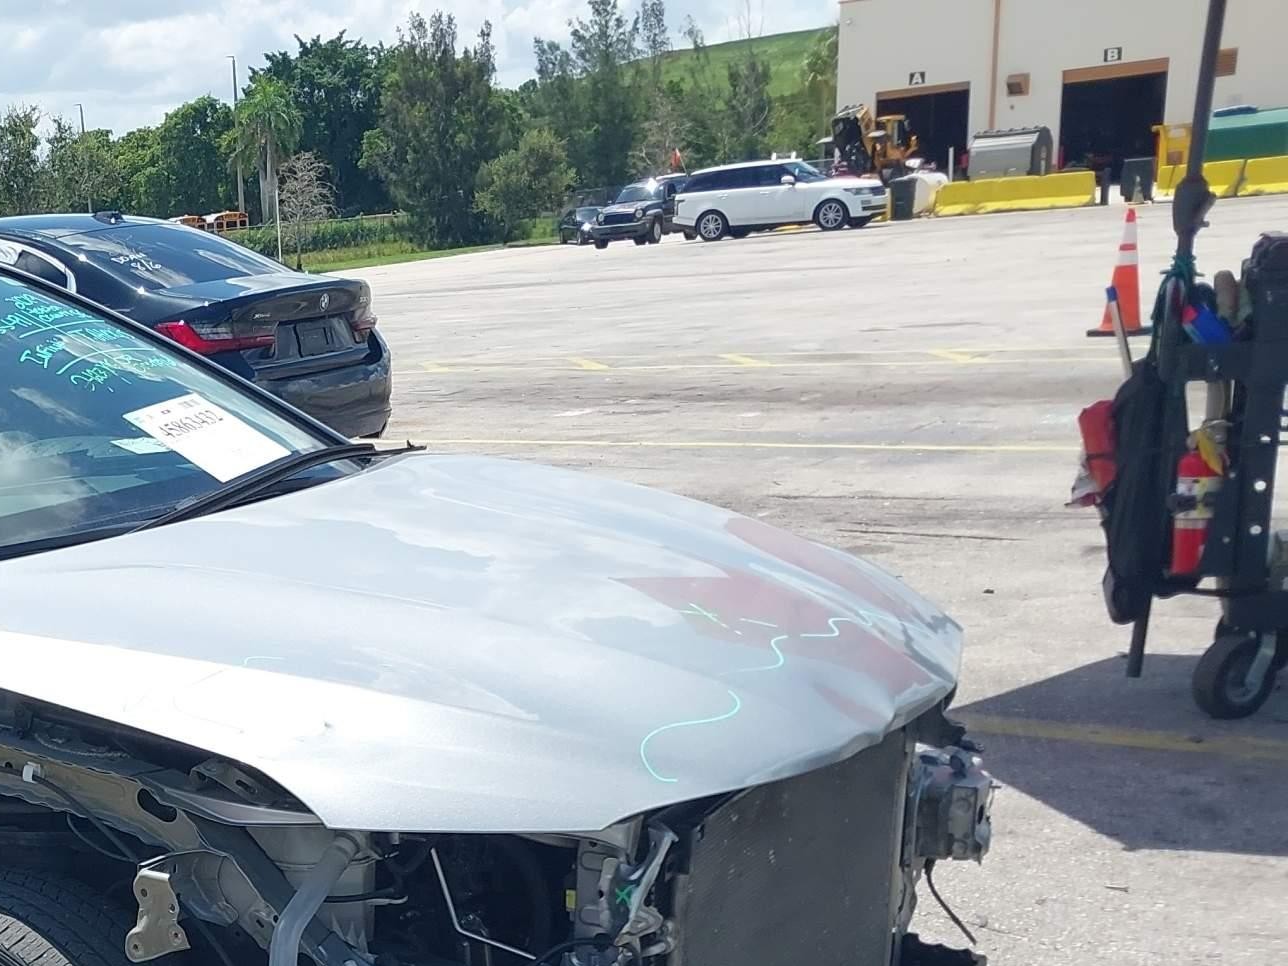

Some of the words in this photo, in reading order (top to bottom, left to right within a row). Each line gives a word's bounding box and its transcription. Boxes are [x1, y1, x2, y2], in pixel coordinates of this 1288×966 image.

[1107, 48, 1118, 60] B
[912, 73, 923, 85] A
[158, 410, 224, 439] 45863432
